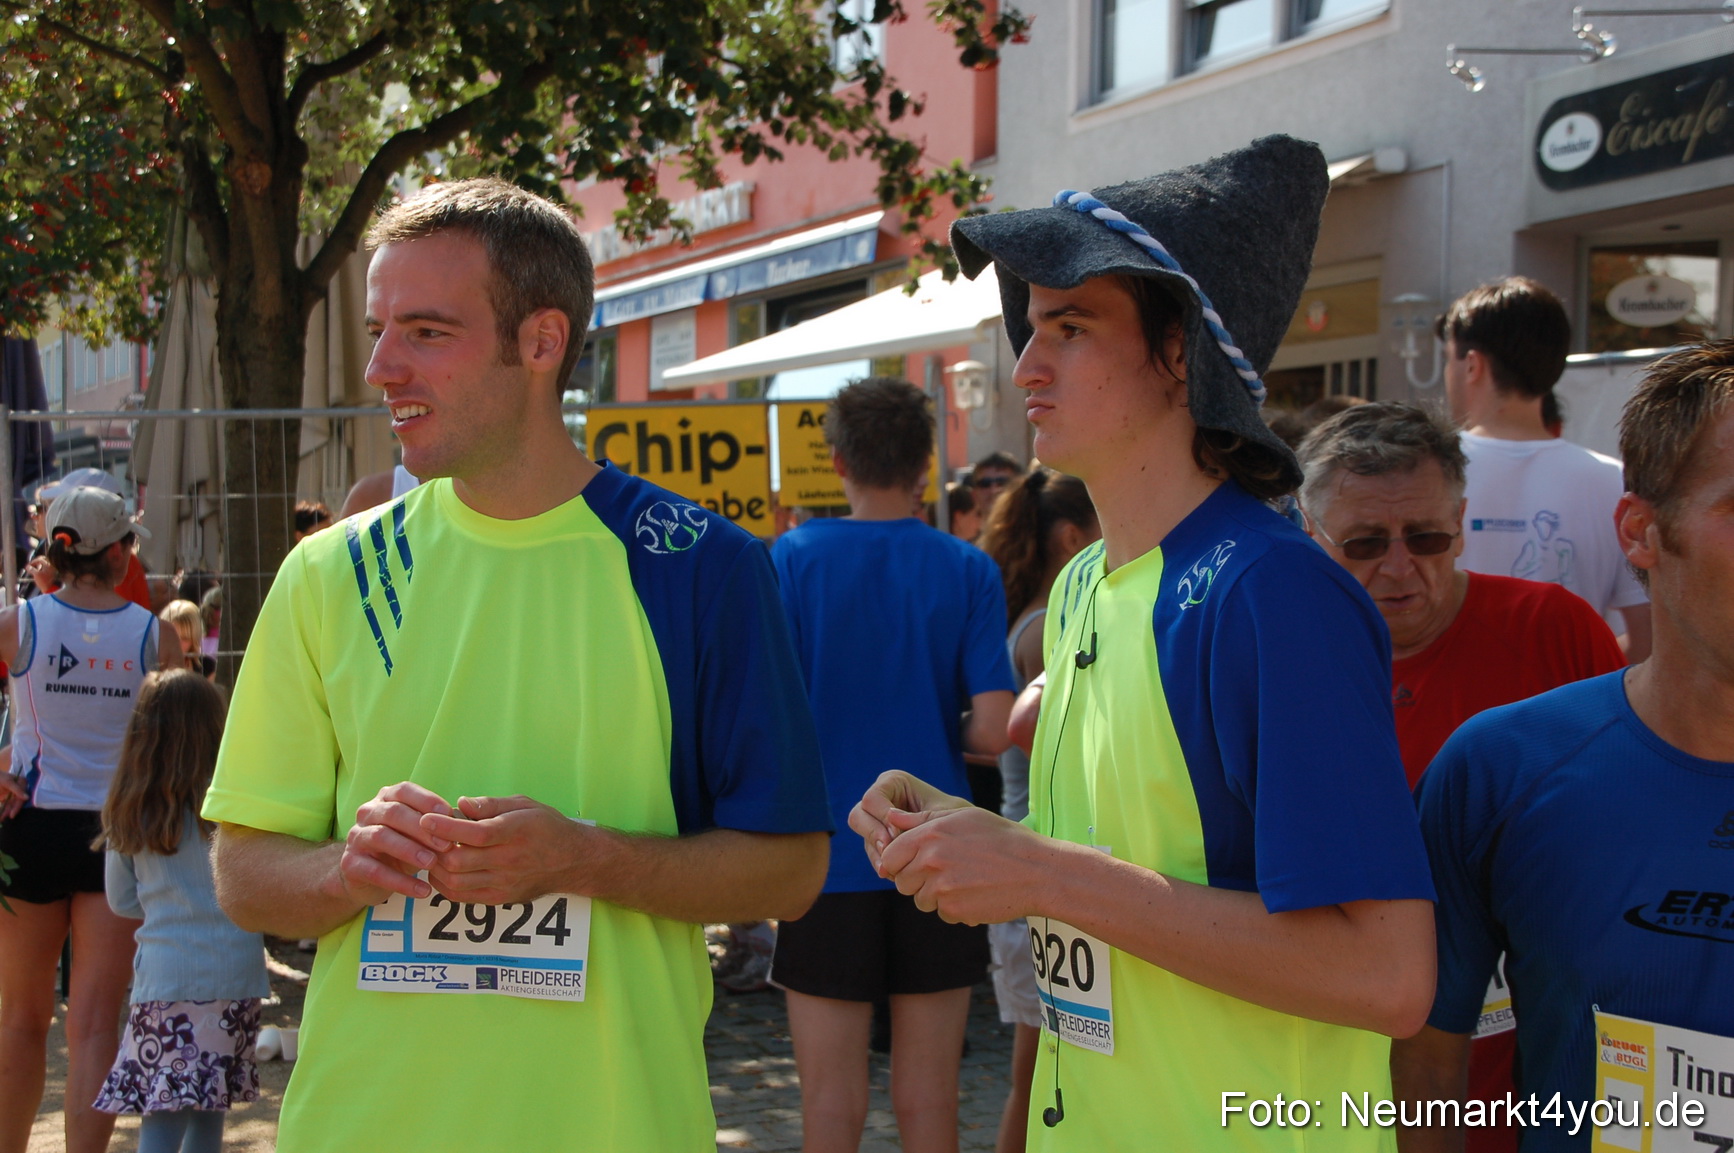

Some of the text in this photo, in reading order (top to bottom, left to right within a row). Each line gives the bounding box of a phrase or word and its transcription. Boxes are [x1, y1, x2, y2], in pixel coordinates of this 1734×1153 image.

[593, 417, 765, 485] Chip-
[45, 683, 131, 698] RUNNING TEAM
[428, 892, 572, 946] 2924
[1656, 890, 1734, 919] ER
[361, 965, 449, 982] BOCK
[1031, 926, 1095, 992] 920
[500, 968, 582, 987] PFLEIDERER
[500, 984, 582, 997] AKTIENGESELLSCHAFT
[1056, 1011, 1112, 1040] PFLEIDERER
